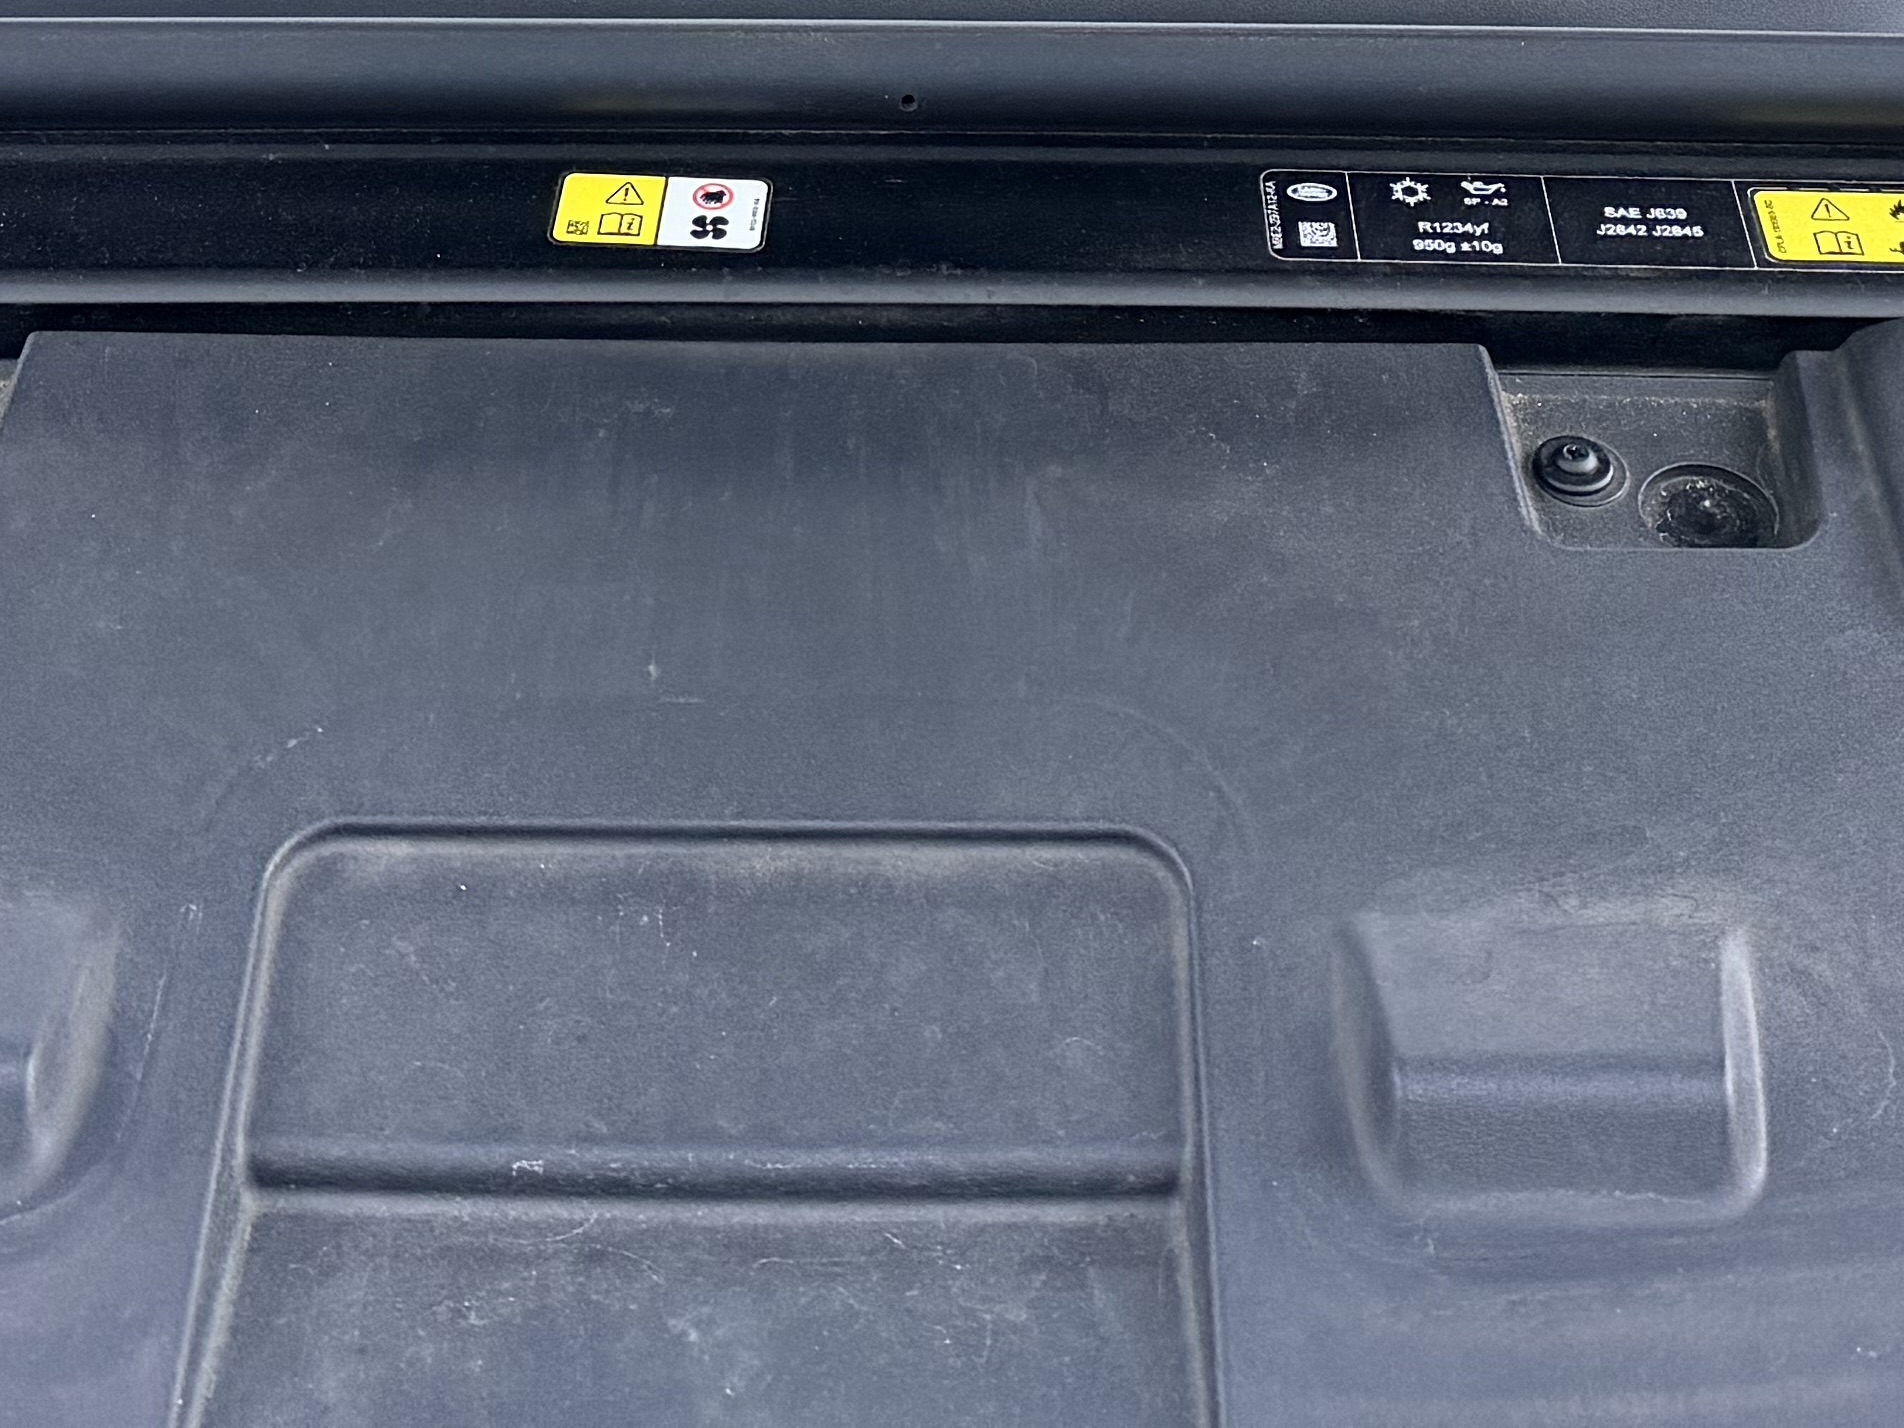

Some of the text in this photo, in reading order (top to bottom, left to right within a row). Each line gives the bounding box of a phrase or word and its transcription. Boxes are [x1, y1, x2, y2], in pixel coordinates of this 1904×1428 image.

[1603, 206, 1642, 218] SAE
[1417, 221, 1490, 236] R1234yf
[1596, 224, 1649, 236] J2842
